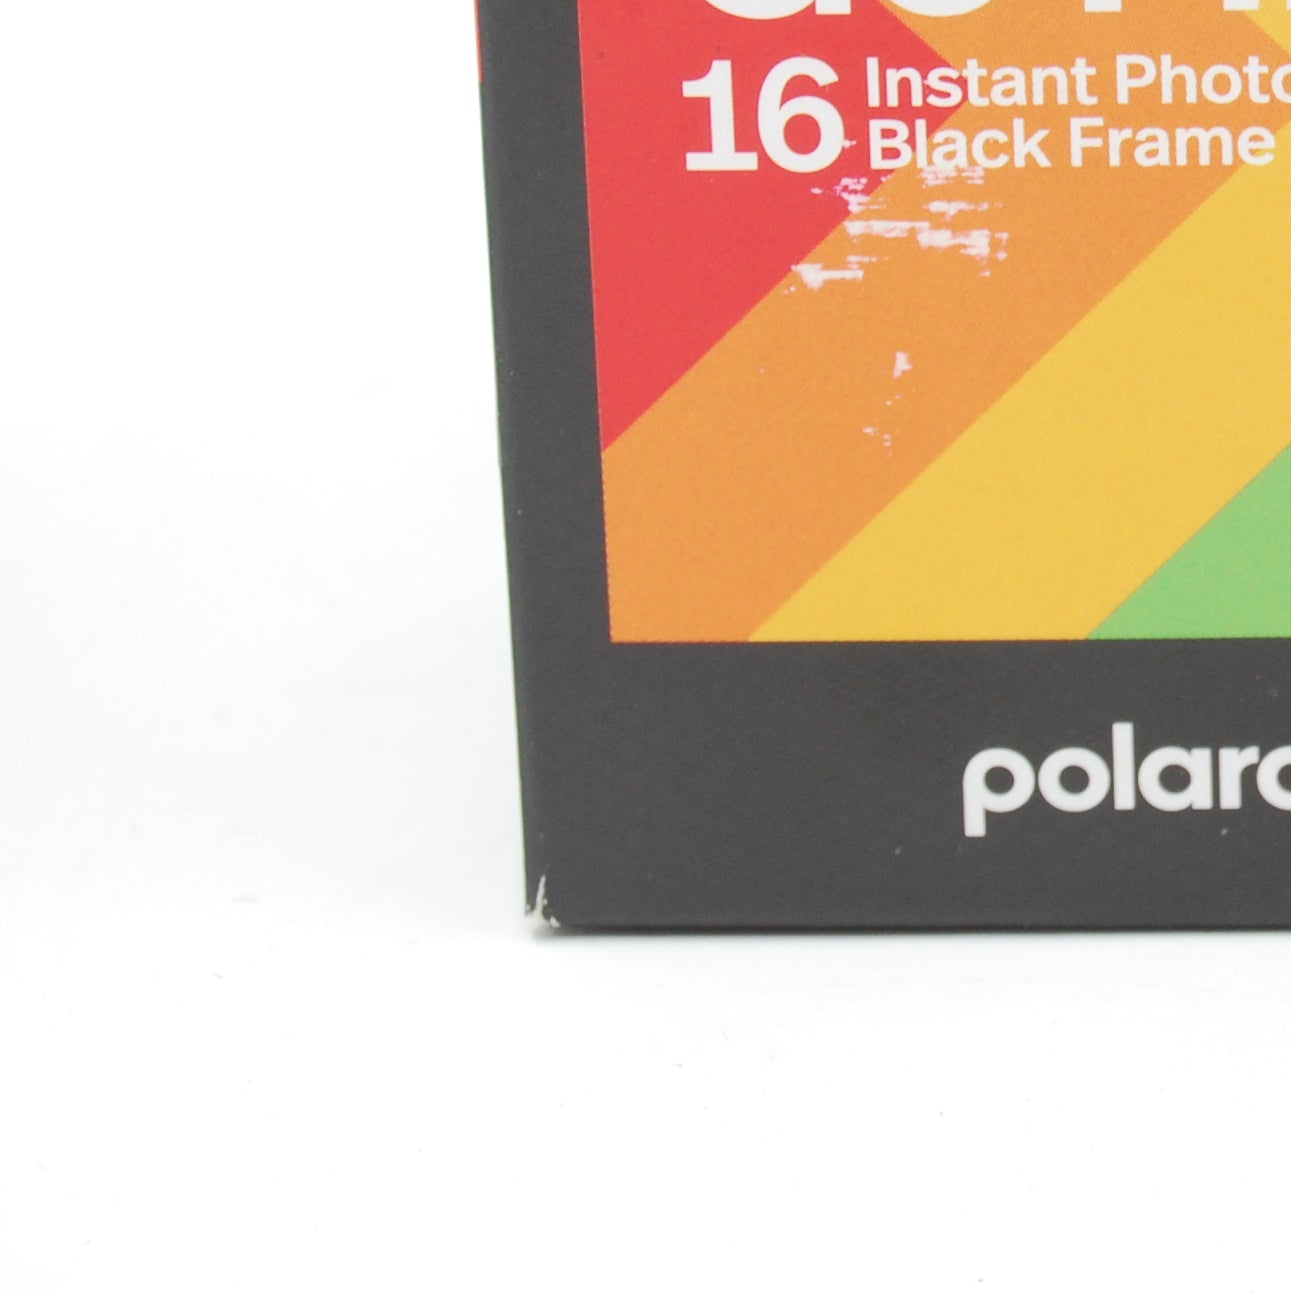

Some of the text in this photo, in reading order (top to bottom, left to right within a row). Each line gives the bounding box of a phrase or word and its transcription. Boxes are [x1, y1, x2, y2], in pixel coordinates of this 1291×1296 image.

[866, 56, 1098, 108] Instant
[681, 56, 847, 173] 16
[867, 116, 1052, 171] Black
[1068, 116, 1277, 168] Frame
